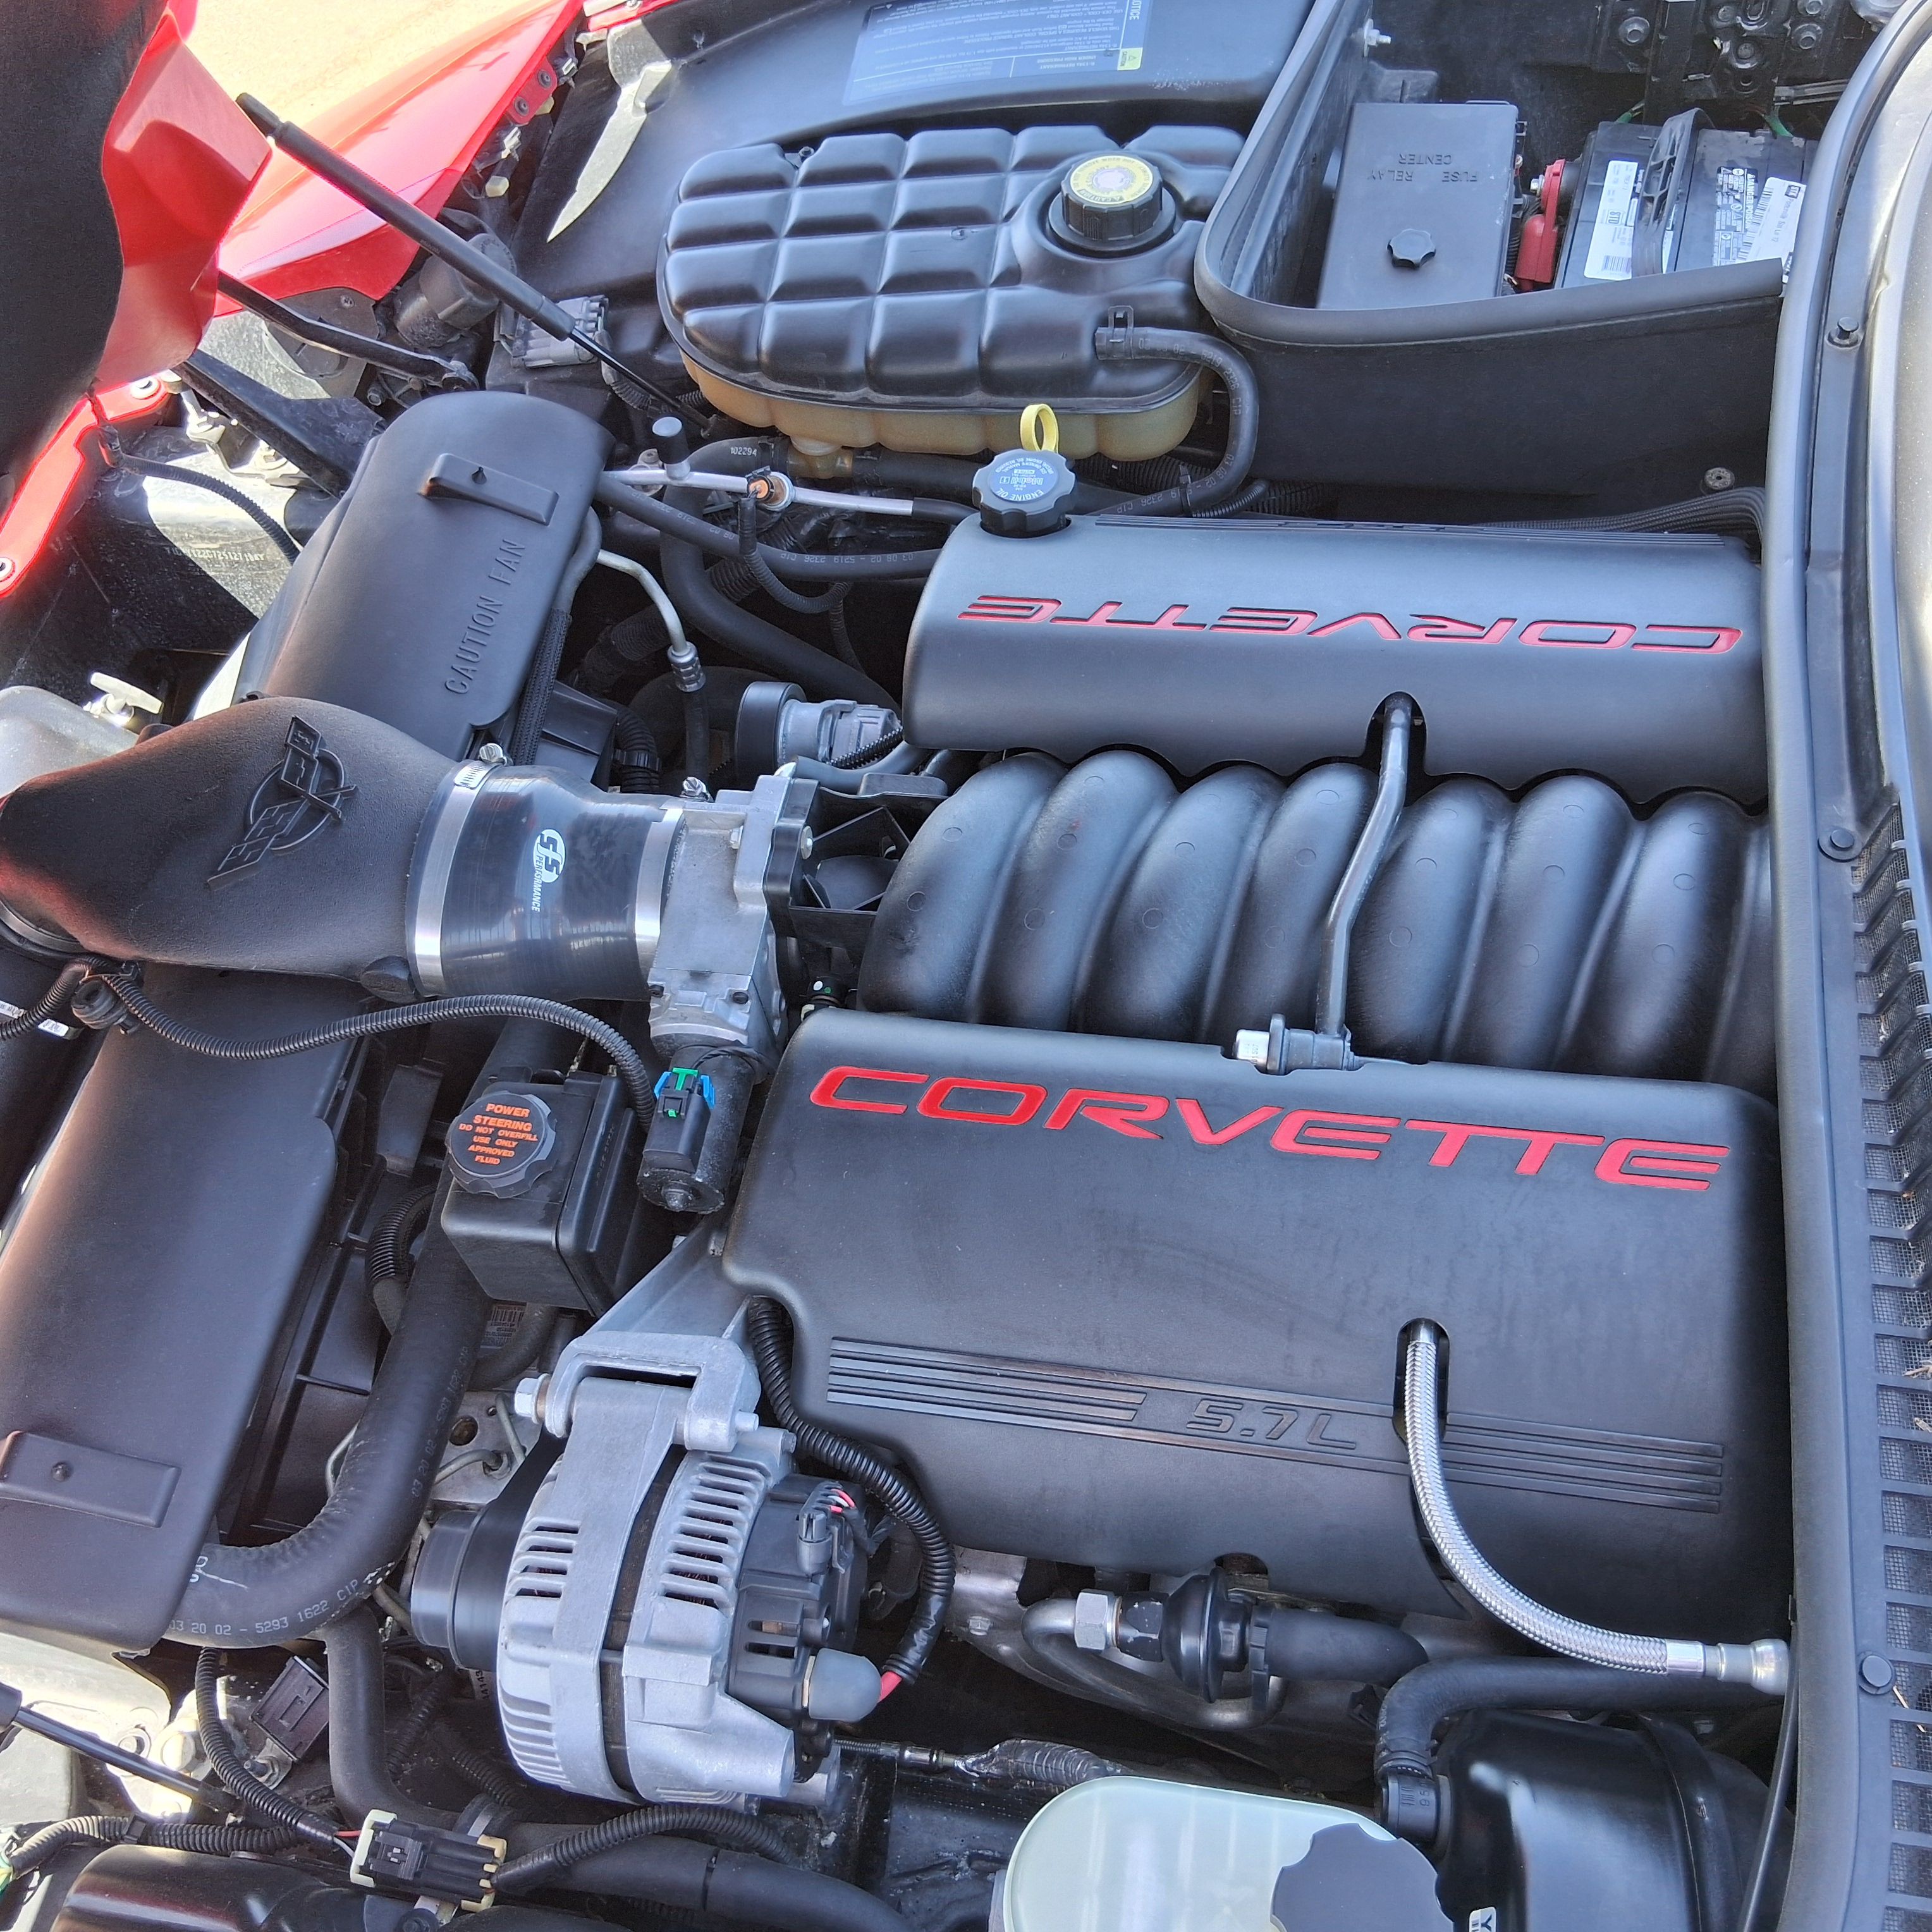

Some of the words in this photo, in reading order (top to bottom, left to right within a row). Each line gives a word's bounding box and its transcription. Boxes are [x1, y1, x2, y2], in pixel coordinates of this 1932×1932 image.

[1129, 0, 1142, 20] OTICE
[1398, 154, 1452, 165] CENTER
[1367, 170, 1414, 182] RELAY
[1442, 171, 1477, 182] FUSE
[996, 487, 1009, 498] OIL
[1009, 489, 1044, 501] ENGINE
[780, 552, 797, 562] CIP
[804, 554, 826, 563] 2326
[444, 594, 504, 695] CAUTION
[487, 538, 526, 586] FAN
[958, 592, 1744, 654] CORVETTE
[530, 854, 544, 913] PERFORMANCE
[486, 1103, 531, 1118] POWER
[472, 1115, 533, 1132] STEERING
[809, 1065, 1730, 1191] CORVETTE
[458, 1123, 473, 1132] DO
[475, 1126, 495, 1135] NOT
[498, 1129, 539, 1142] OVERFILL
[472, 1135, 491, 1144] USE
[494, 1139, 519, 1148] ONLY
[467, 1144, 516, 1158] APPROVED
[474, 1156, 501, 1165] FLUID
[1185, 1397, 1357, 1450] 5.7L
[192, 1622, 207, 1634] 20
[215, 1624, 231, 1636] 02
[255, 1616, 289, 1634] 5293
[297, 1600, 330, 1623] 1622
[336, 1579, 359, 1601] CIP
